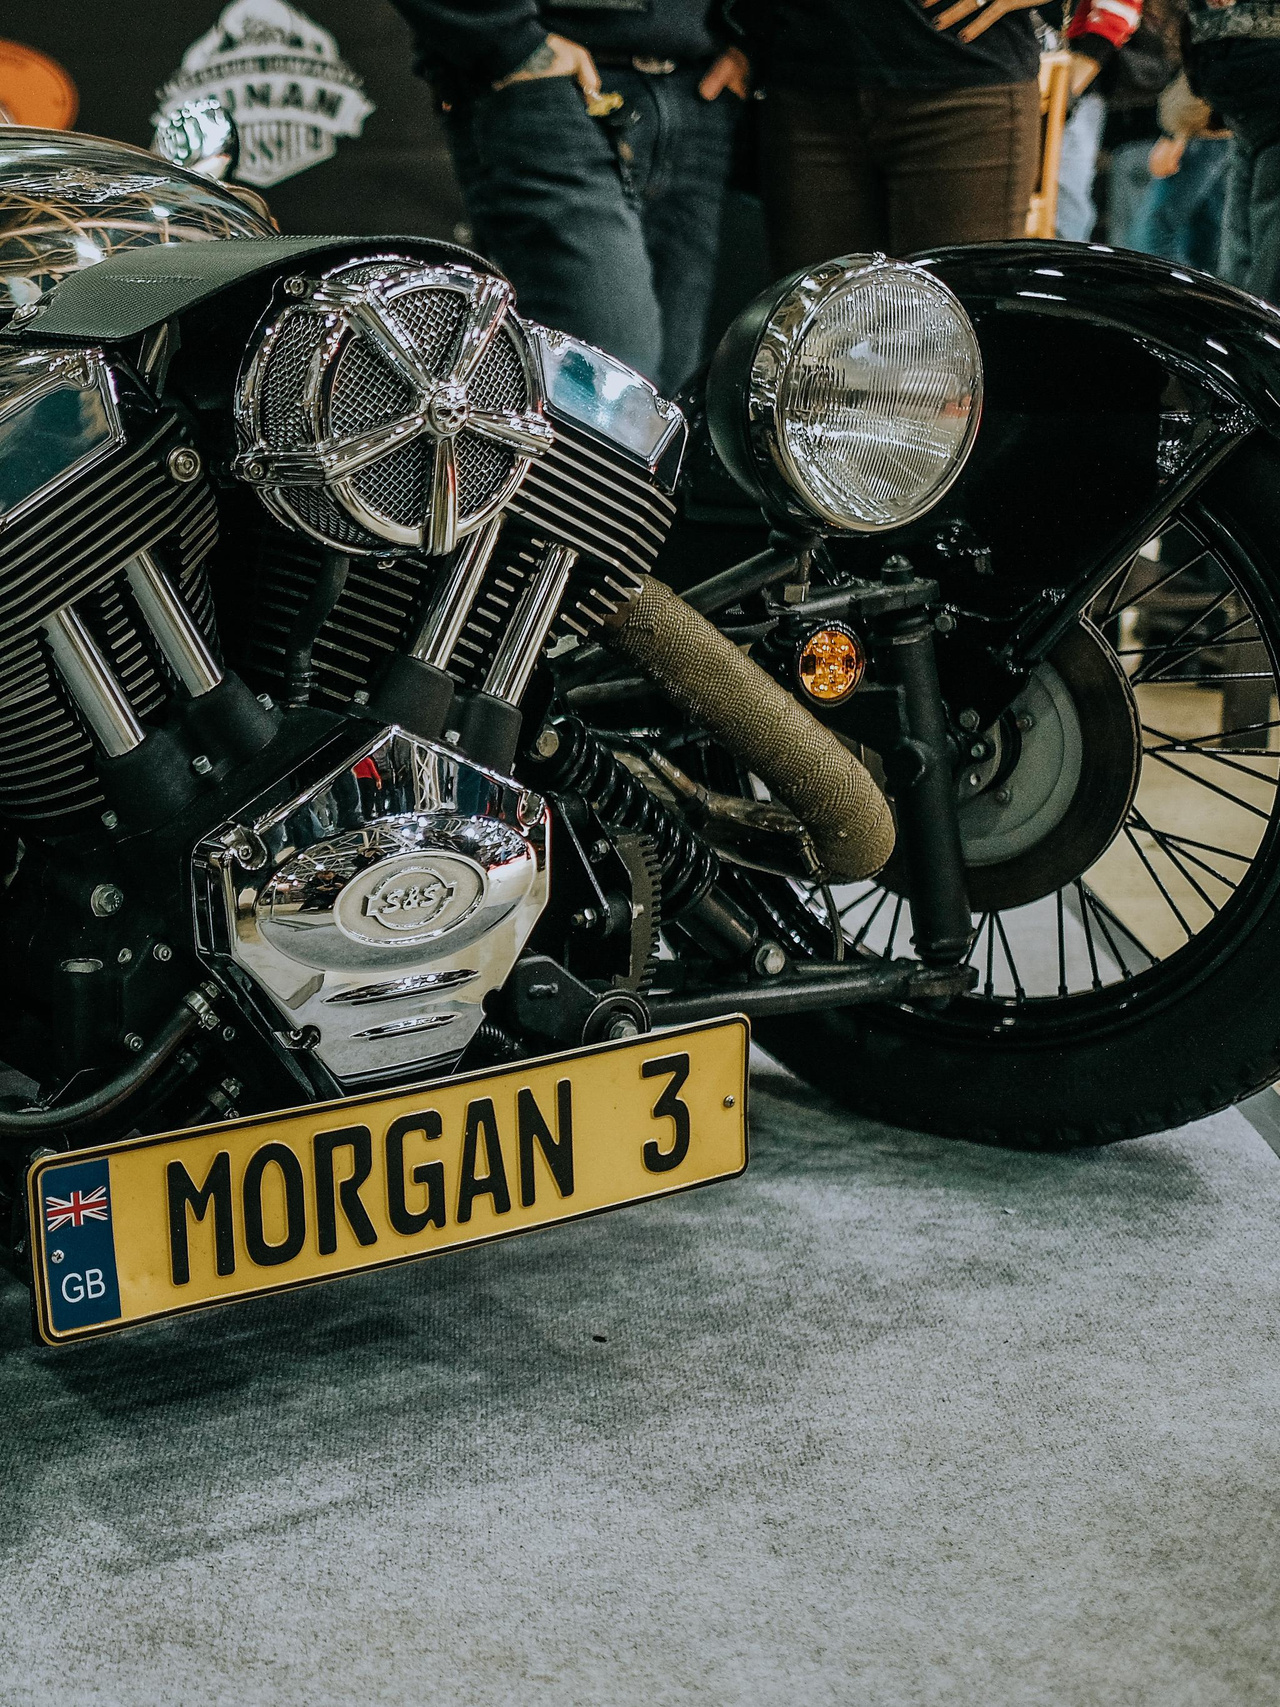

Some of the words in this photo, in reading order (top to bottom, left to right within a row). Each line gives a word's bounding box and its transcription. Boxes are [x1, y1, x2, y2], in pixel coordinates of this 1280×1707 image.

[380, 882, 443, 915] S&S
[166, 1078, 576, 1287] MORGAN
[640, 1052, 691, 1173] 3
[61, 1268, 107, 1304] GB
